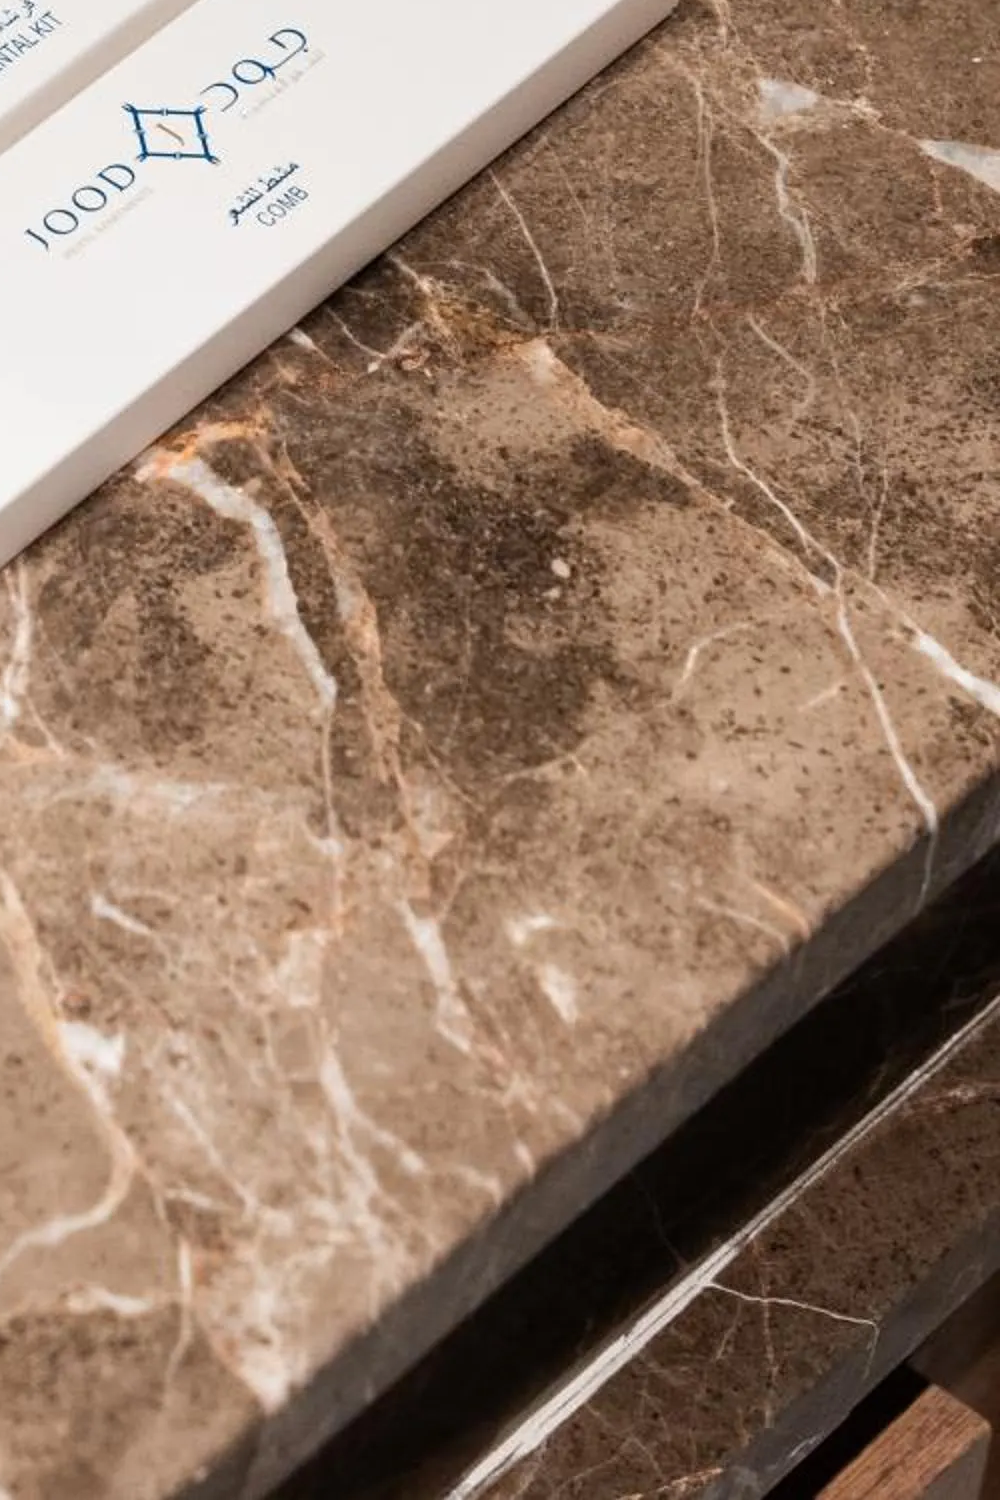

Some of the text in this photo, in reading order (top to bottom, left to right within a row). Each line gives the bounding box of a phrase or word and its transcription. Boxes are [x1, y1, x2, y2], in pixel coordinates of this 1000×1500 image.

[28, 11, 63, 37] KIT
[198, 28, 308, 112] جود
[24, 164, 136, 251] JOOD
[256, 186, 309, 227] COMB
